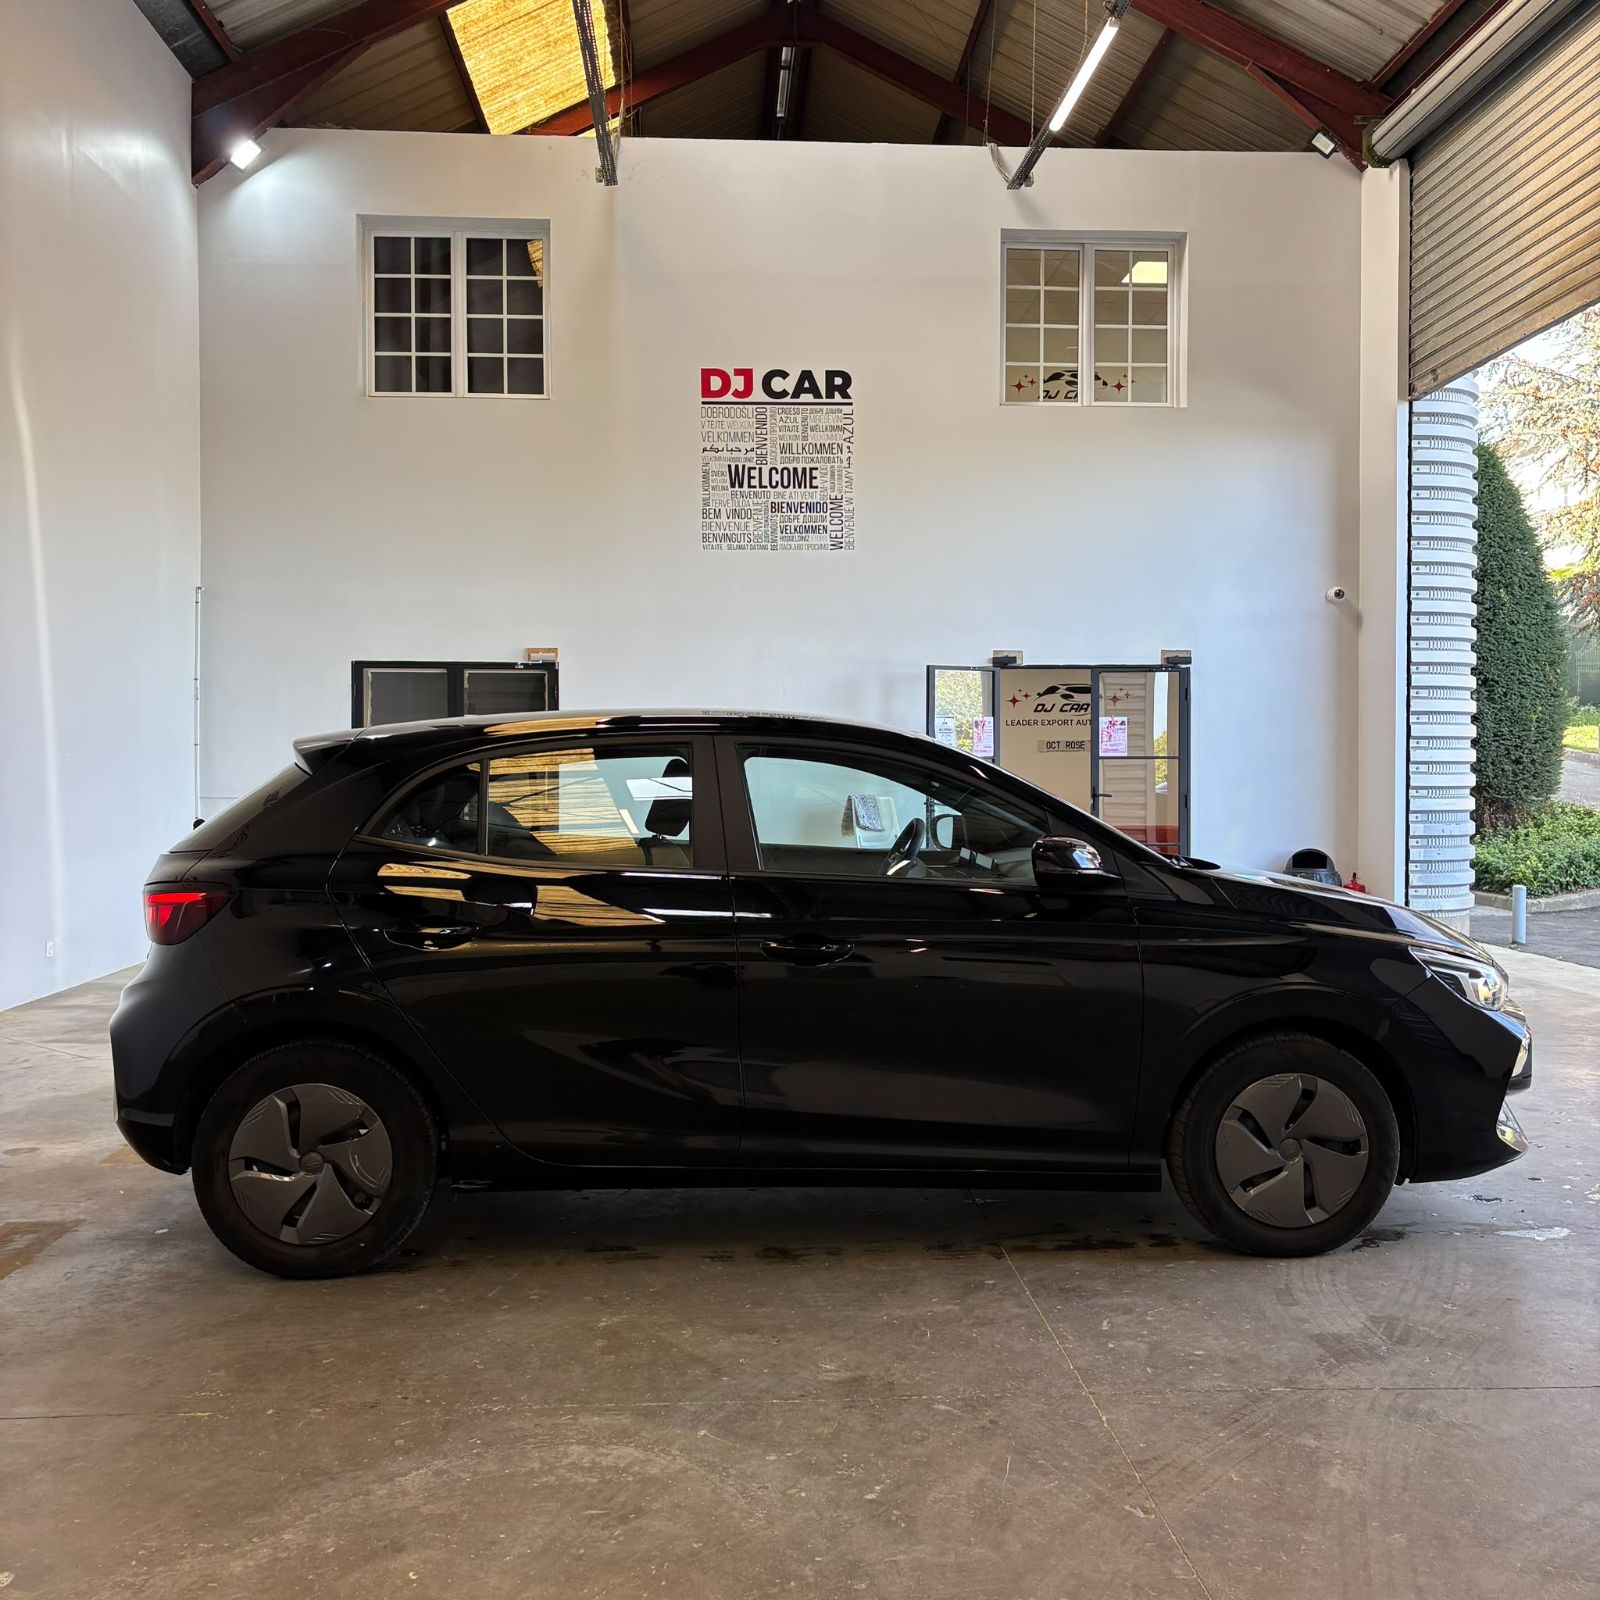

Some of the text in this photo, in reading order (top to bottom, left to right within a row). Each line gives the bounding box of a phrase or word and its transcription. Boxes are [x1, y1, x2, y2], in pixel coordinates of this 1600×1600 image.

[701, 368, 852, 400] DJ CAR
[778, 416, 800, 424] AZUL
[843, 409, 854, 444] AZUL
[701, 431, 754, 442] VELKOMMEN
[755, 406, 768, 465] BIENVENIDO
[779, 443, 843, 455] WILLKOMMEN
[727, 464, 818, 489] WELCOME
[730, 490, 770, 499] BENVENUTO
[770, 501, 828, 514] BIENVENIDO
[702, 508, 752, 519] BEM VINDO
[702, 521, 750, 531] BIENVENUE
[829, 494, 843, 551] WELCOME
[779, 525, 828, 534] VELKOMMEN
[702, 532, 752, 543] BENVINGUTS
[1033, 703, 1091, 713] DJ CAR
[1046, 741, 1085, 749] OCT ROSE
